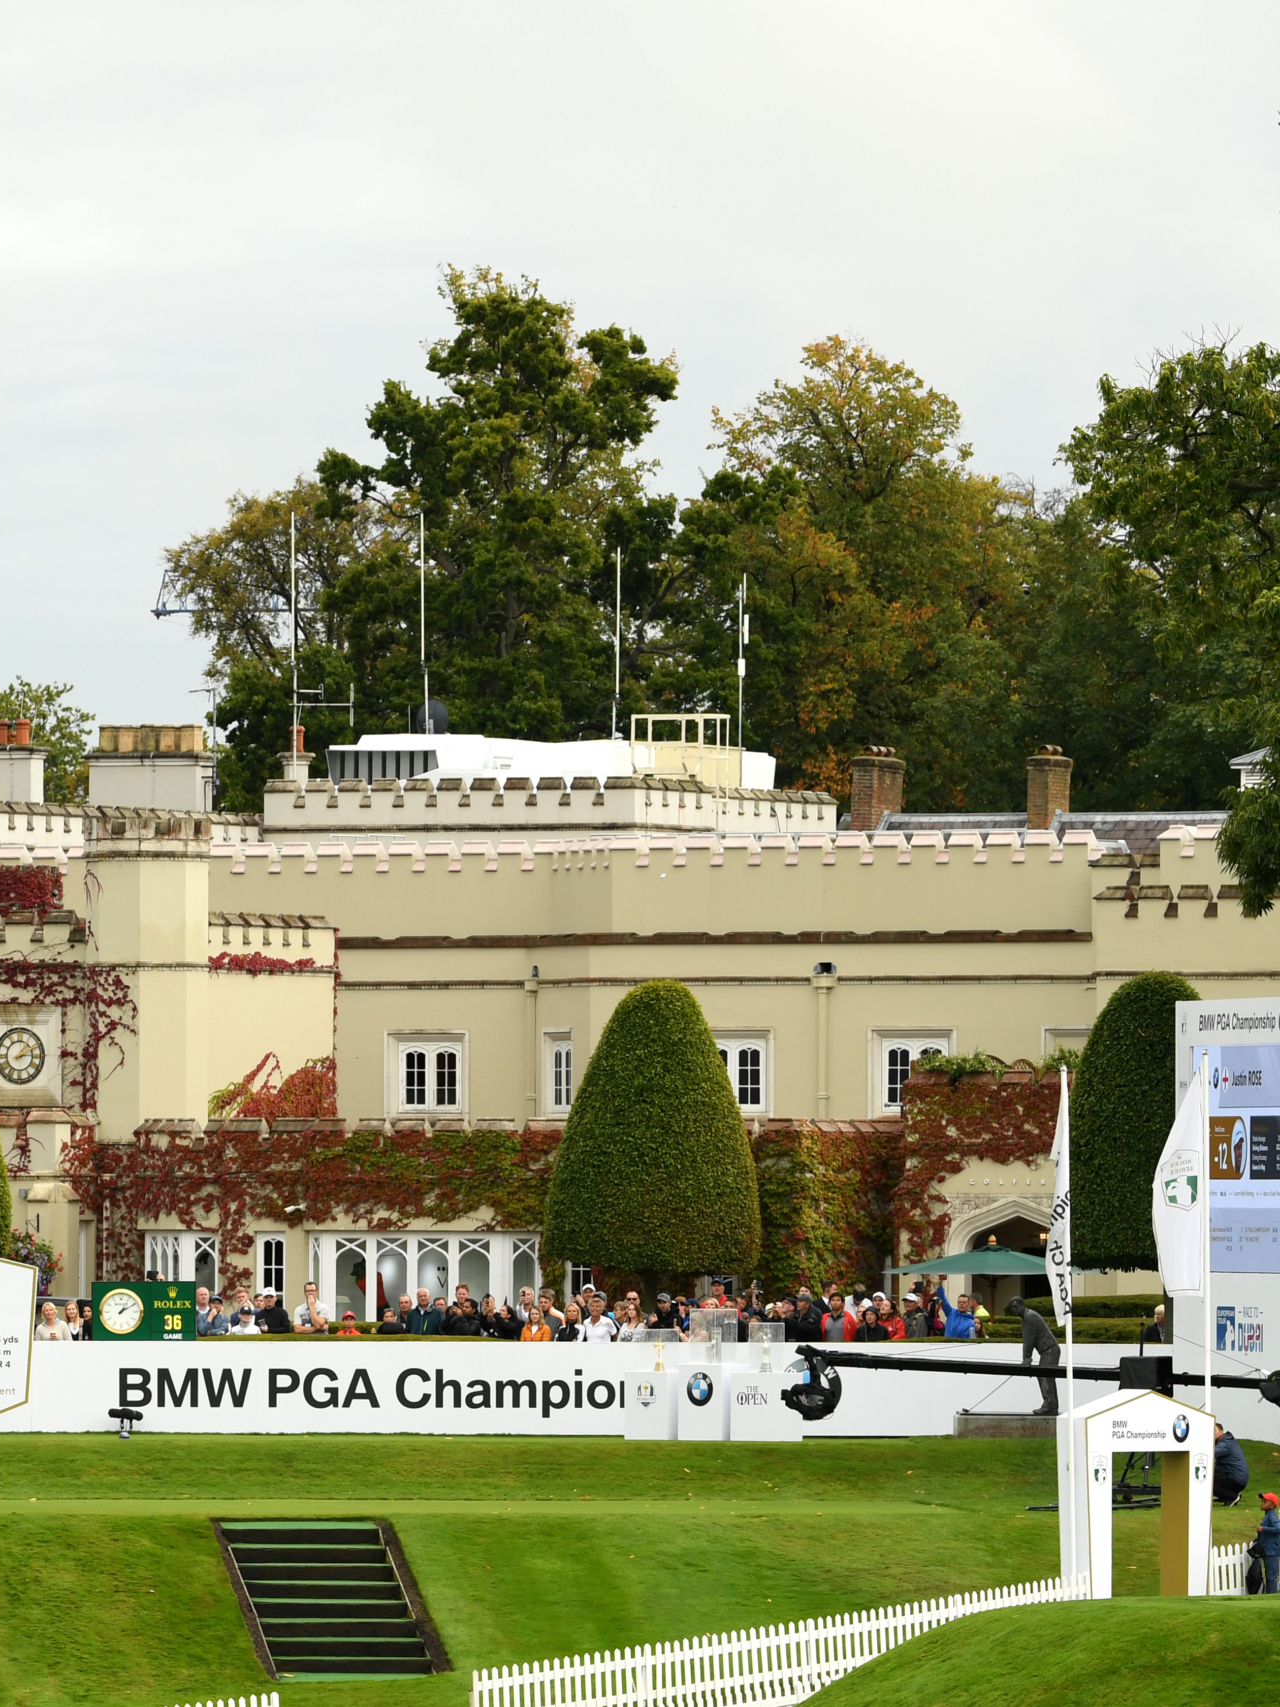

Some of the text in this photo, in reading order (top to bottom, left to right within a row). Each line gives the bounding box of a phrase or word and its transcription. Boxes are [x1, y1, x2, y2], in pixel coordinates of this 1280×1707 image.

[1199, 1012, 1276, 1033] BMW PGA Championship
[1232, 1070, 1262, 1086] Justin ROSE
[153, 1301, 192, 1309] ROLEX
[164, 1314, 182, 1330] 36
[3, 1335, 19, 1345] yds
[119, 1367, 625, 1419] BMW PGA Champio
[736, 1391, 768, 1405] OPEN
[1112, 1420, 1128, 1428] BMW
[1112, 1430, 1166, 1440] PGA Championship
